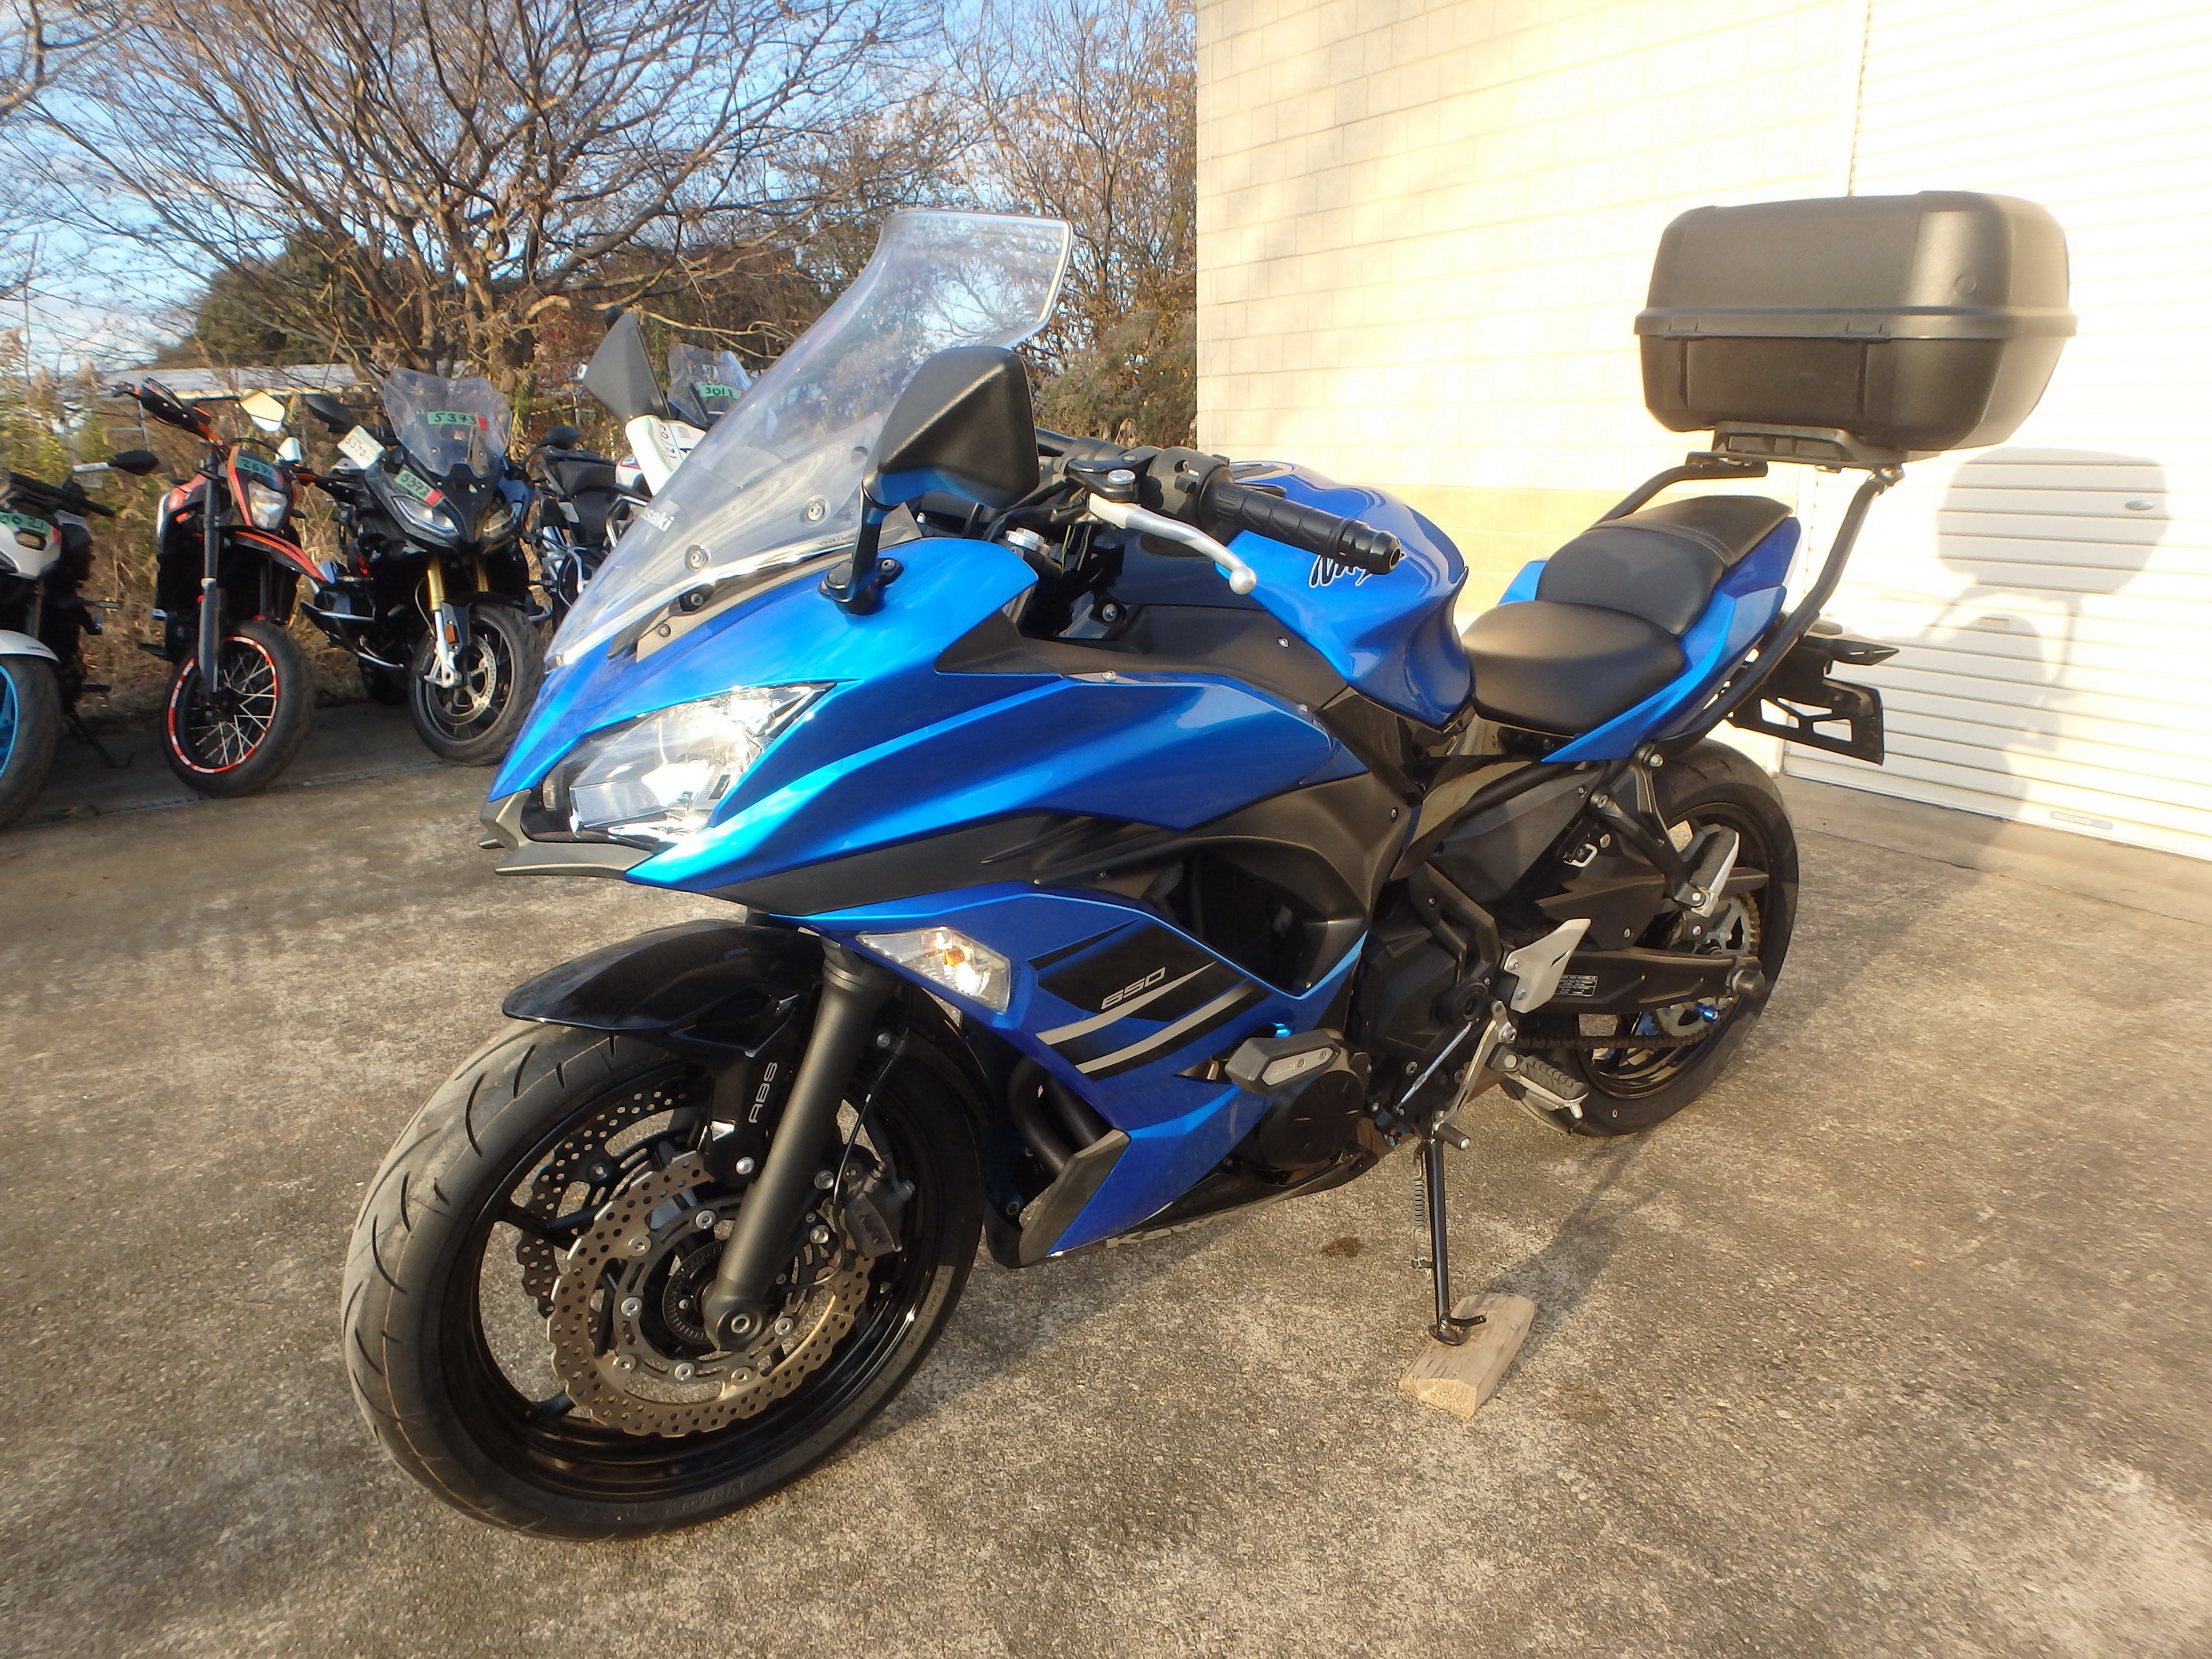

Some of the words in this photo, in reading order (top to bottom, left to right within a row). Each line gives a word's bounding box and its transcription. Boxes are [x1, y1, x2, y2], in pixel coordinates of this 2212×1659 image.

[434, 412, 477, 425] 5373
[345, 437, 367, 457] 5373
[401, 472, 431, 496] 5373
[1100, 966, 1167, 1010] 650
[747, 1061, 779, 1124] ABS
